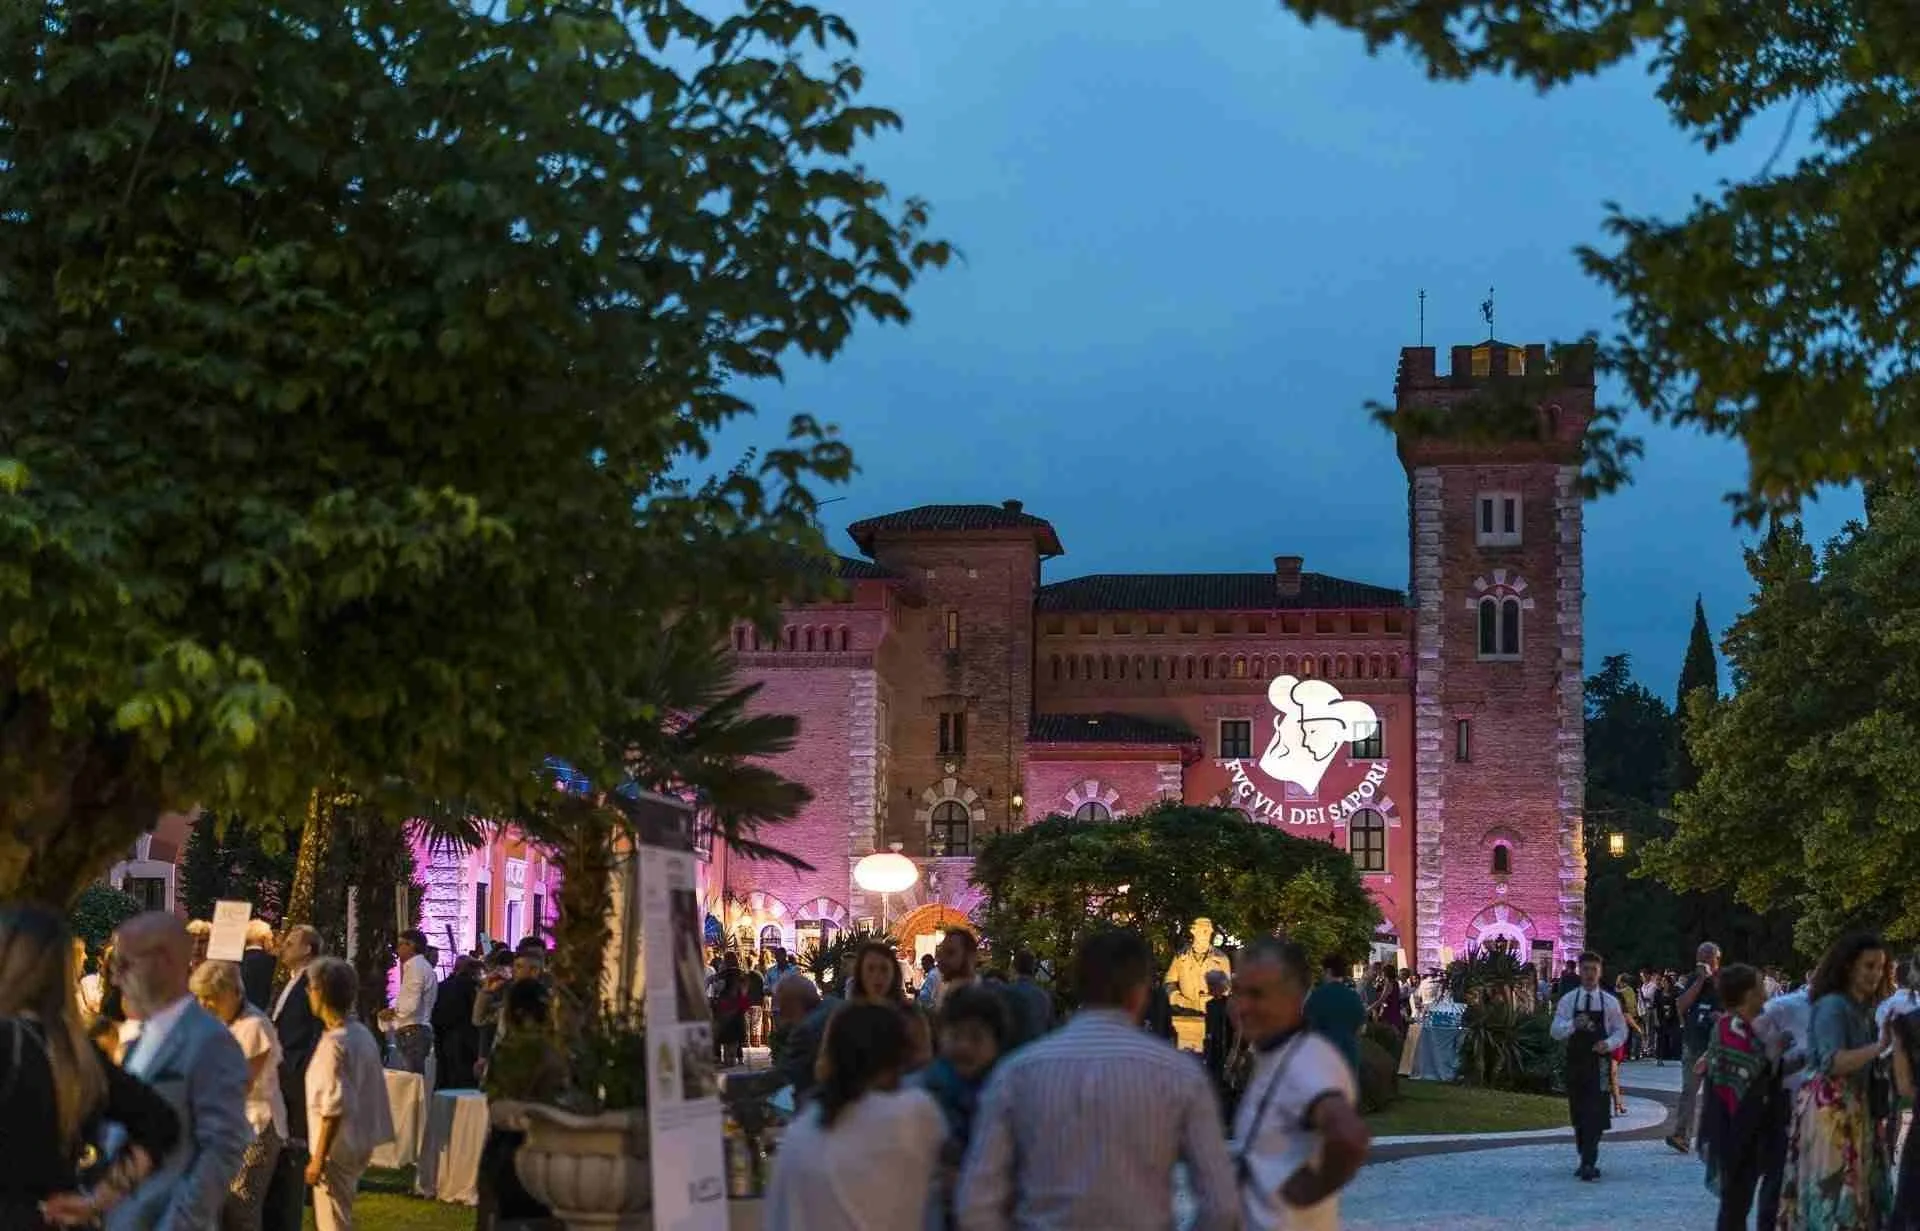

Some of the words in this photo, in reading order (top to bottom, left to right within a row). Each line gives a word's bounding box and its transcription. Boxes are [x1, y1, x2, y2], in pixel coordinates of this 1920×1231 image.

[1224, 758, 1255, 797] FVG
[1254, 792, 1283, 821] VIA
[1290, 808, 1325, 824] DEI
[1328, 762, 1388, 821] SAPORI
